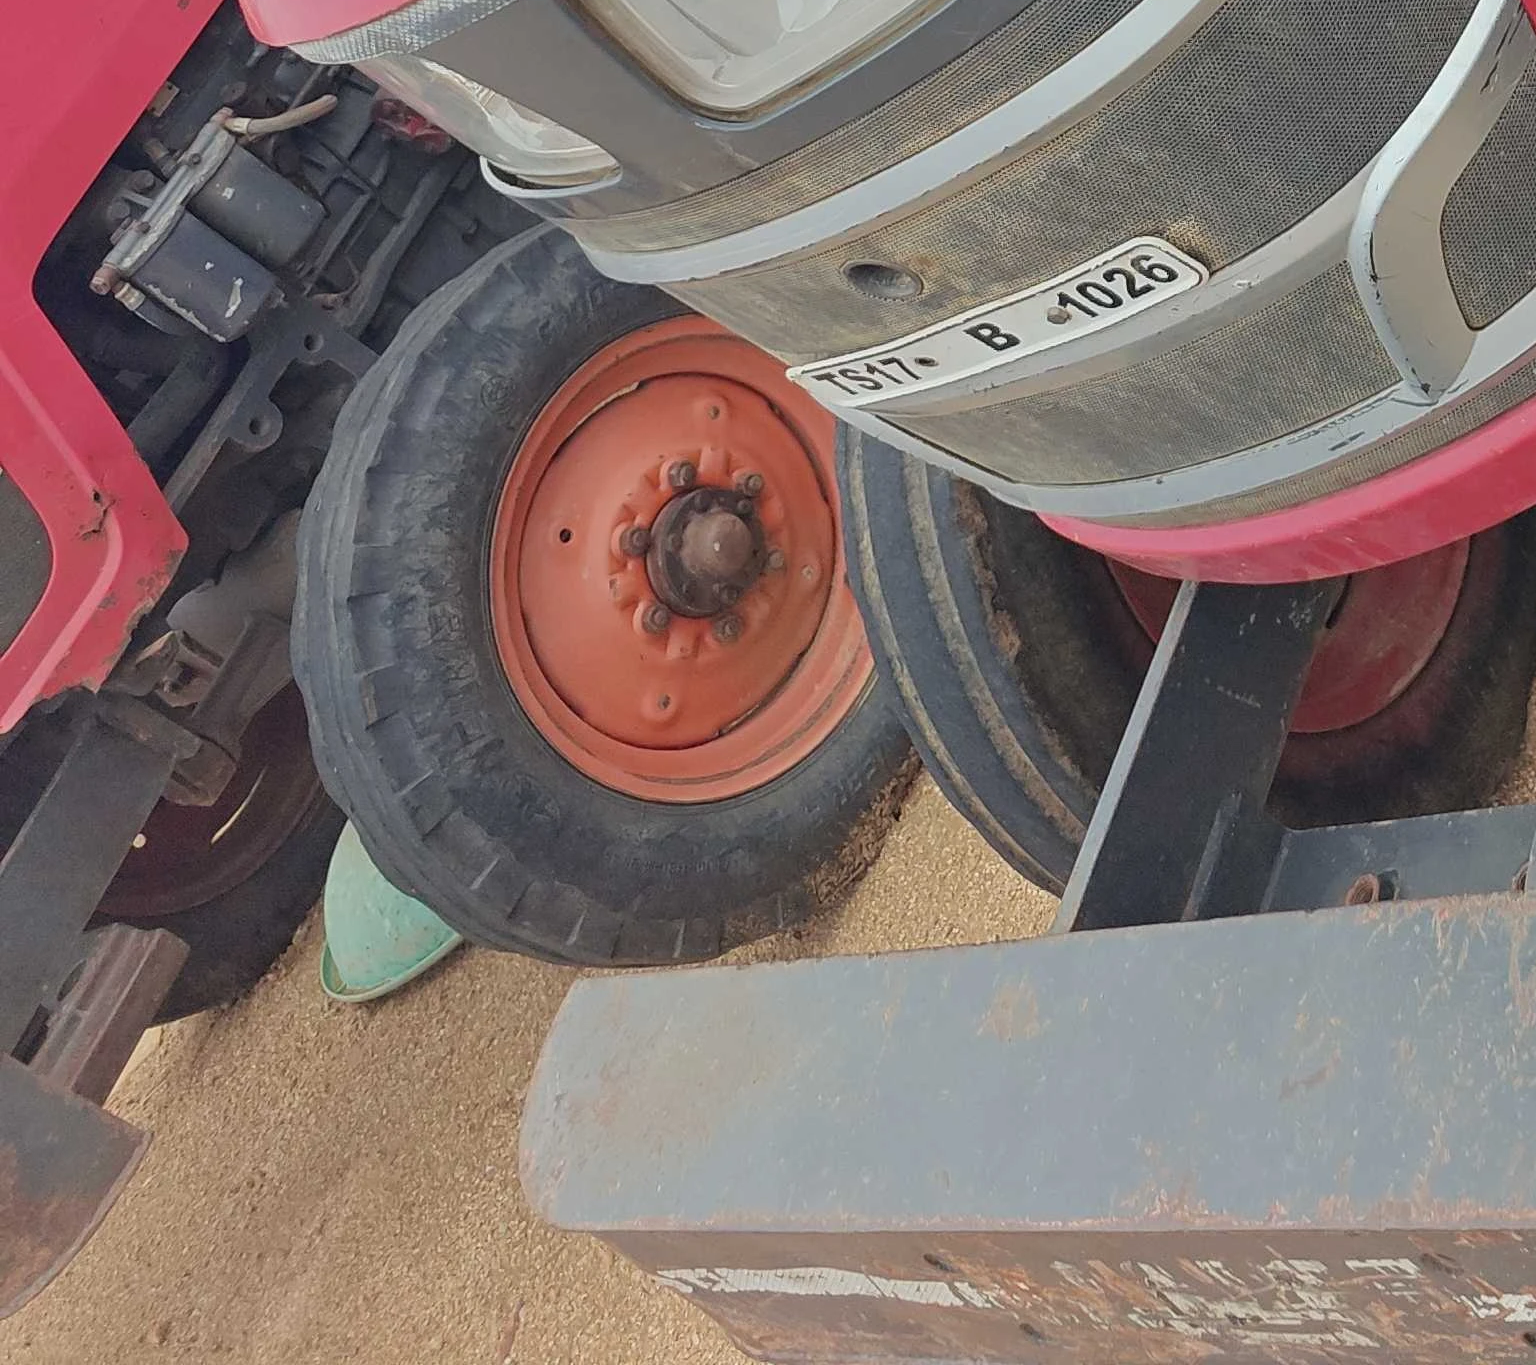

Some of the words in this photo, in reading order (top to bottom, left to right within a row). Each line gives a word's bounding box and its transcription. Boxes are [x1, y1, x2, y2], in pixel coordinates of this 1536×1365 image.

[810, 355, 923, 396] TS17
[963, 321, 1020, 352] B
[1057, 254, 1180, 319] 1026
